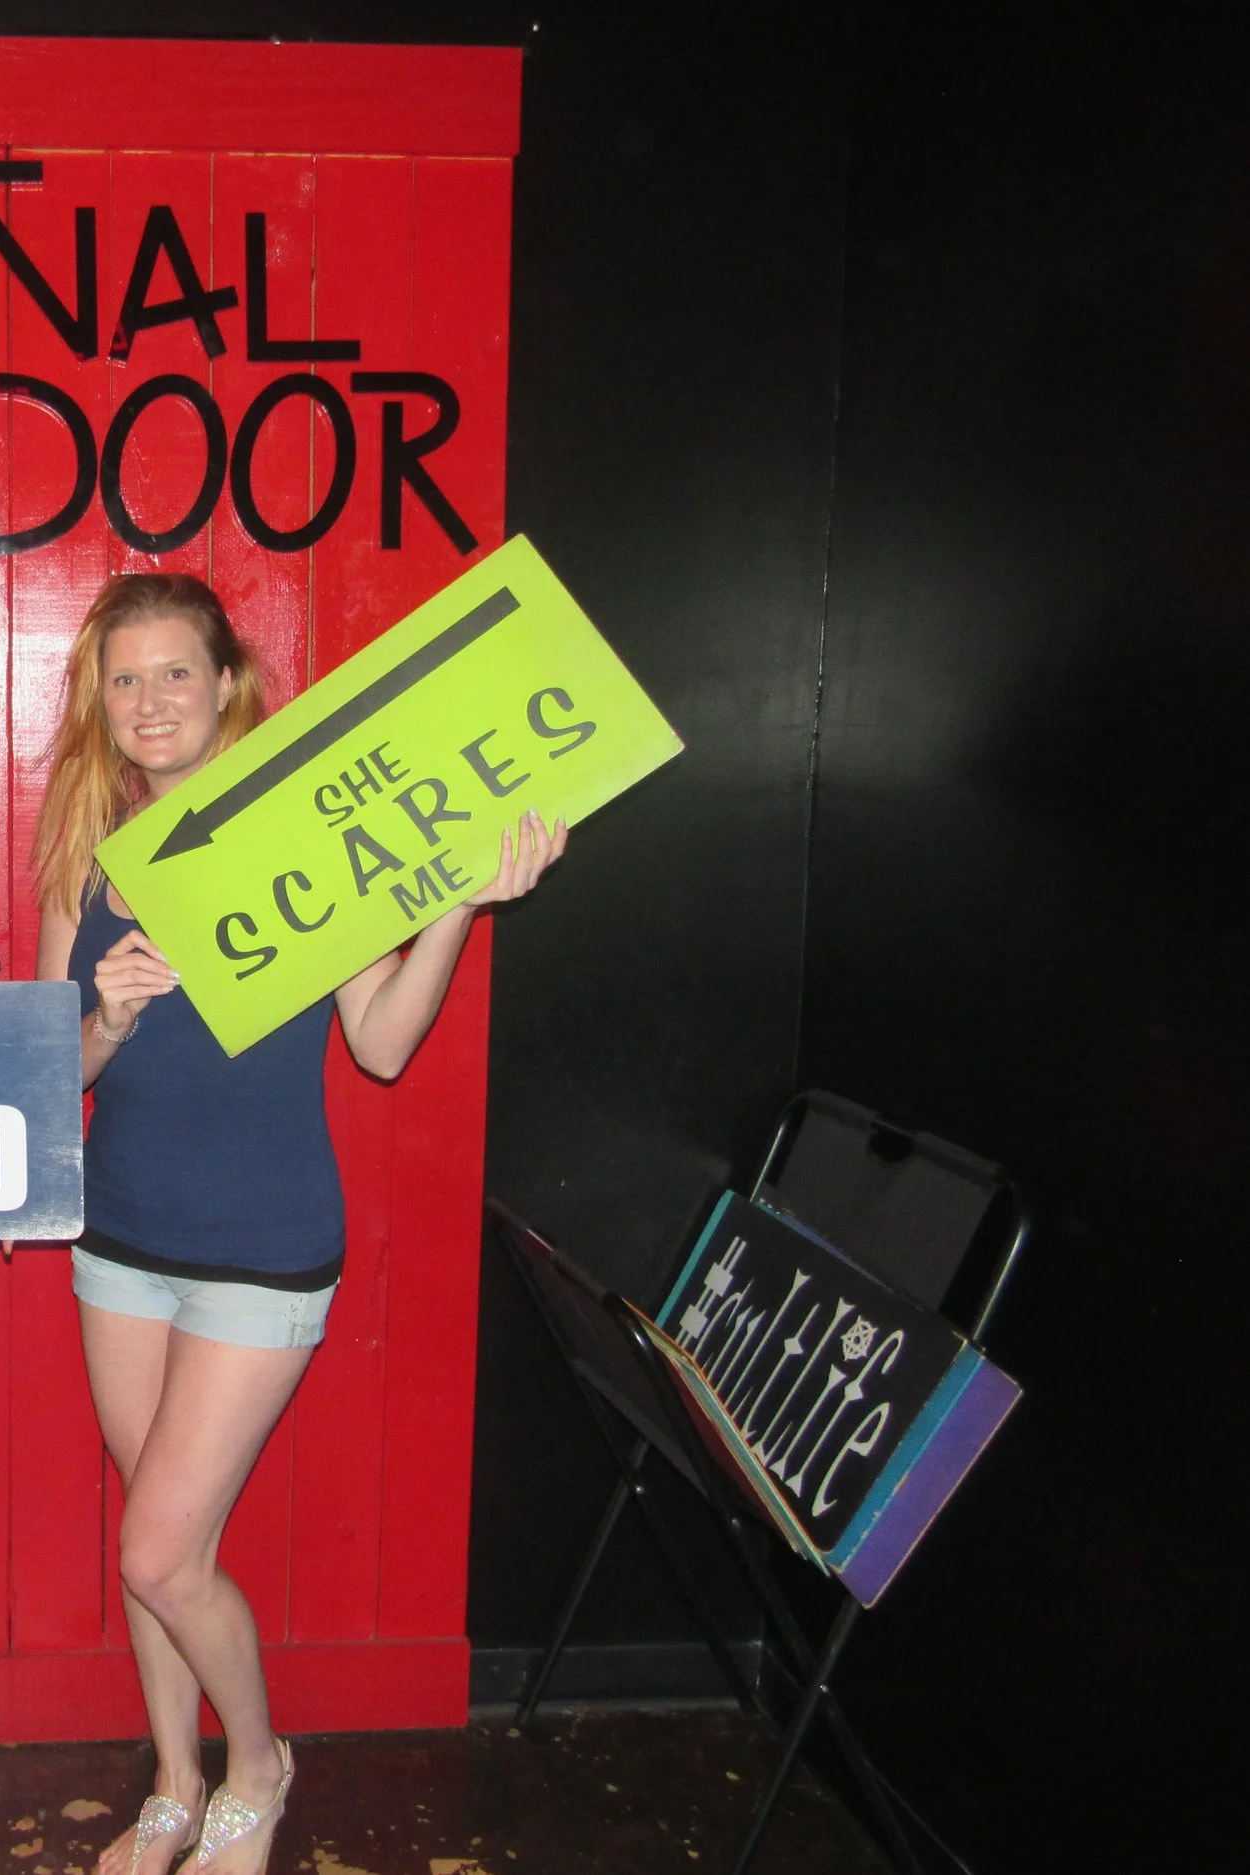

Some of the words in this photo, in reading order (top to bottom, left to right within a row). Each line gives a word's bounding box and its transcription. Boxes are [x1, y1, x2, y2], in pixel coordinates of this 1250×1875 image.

[313, 741, 411, 828] SHE
[215, 687, 597, 981] SCARES
[389, 849, 473, 921] ME
